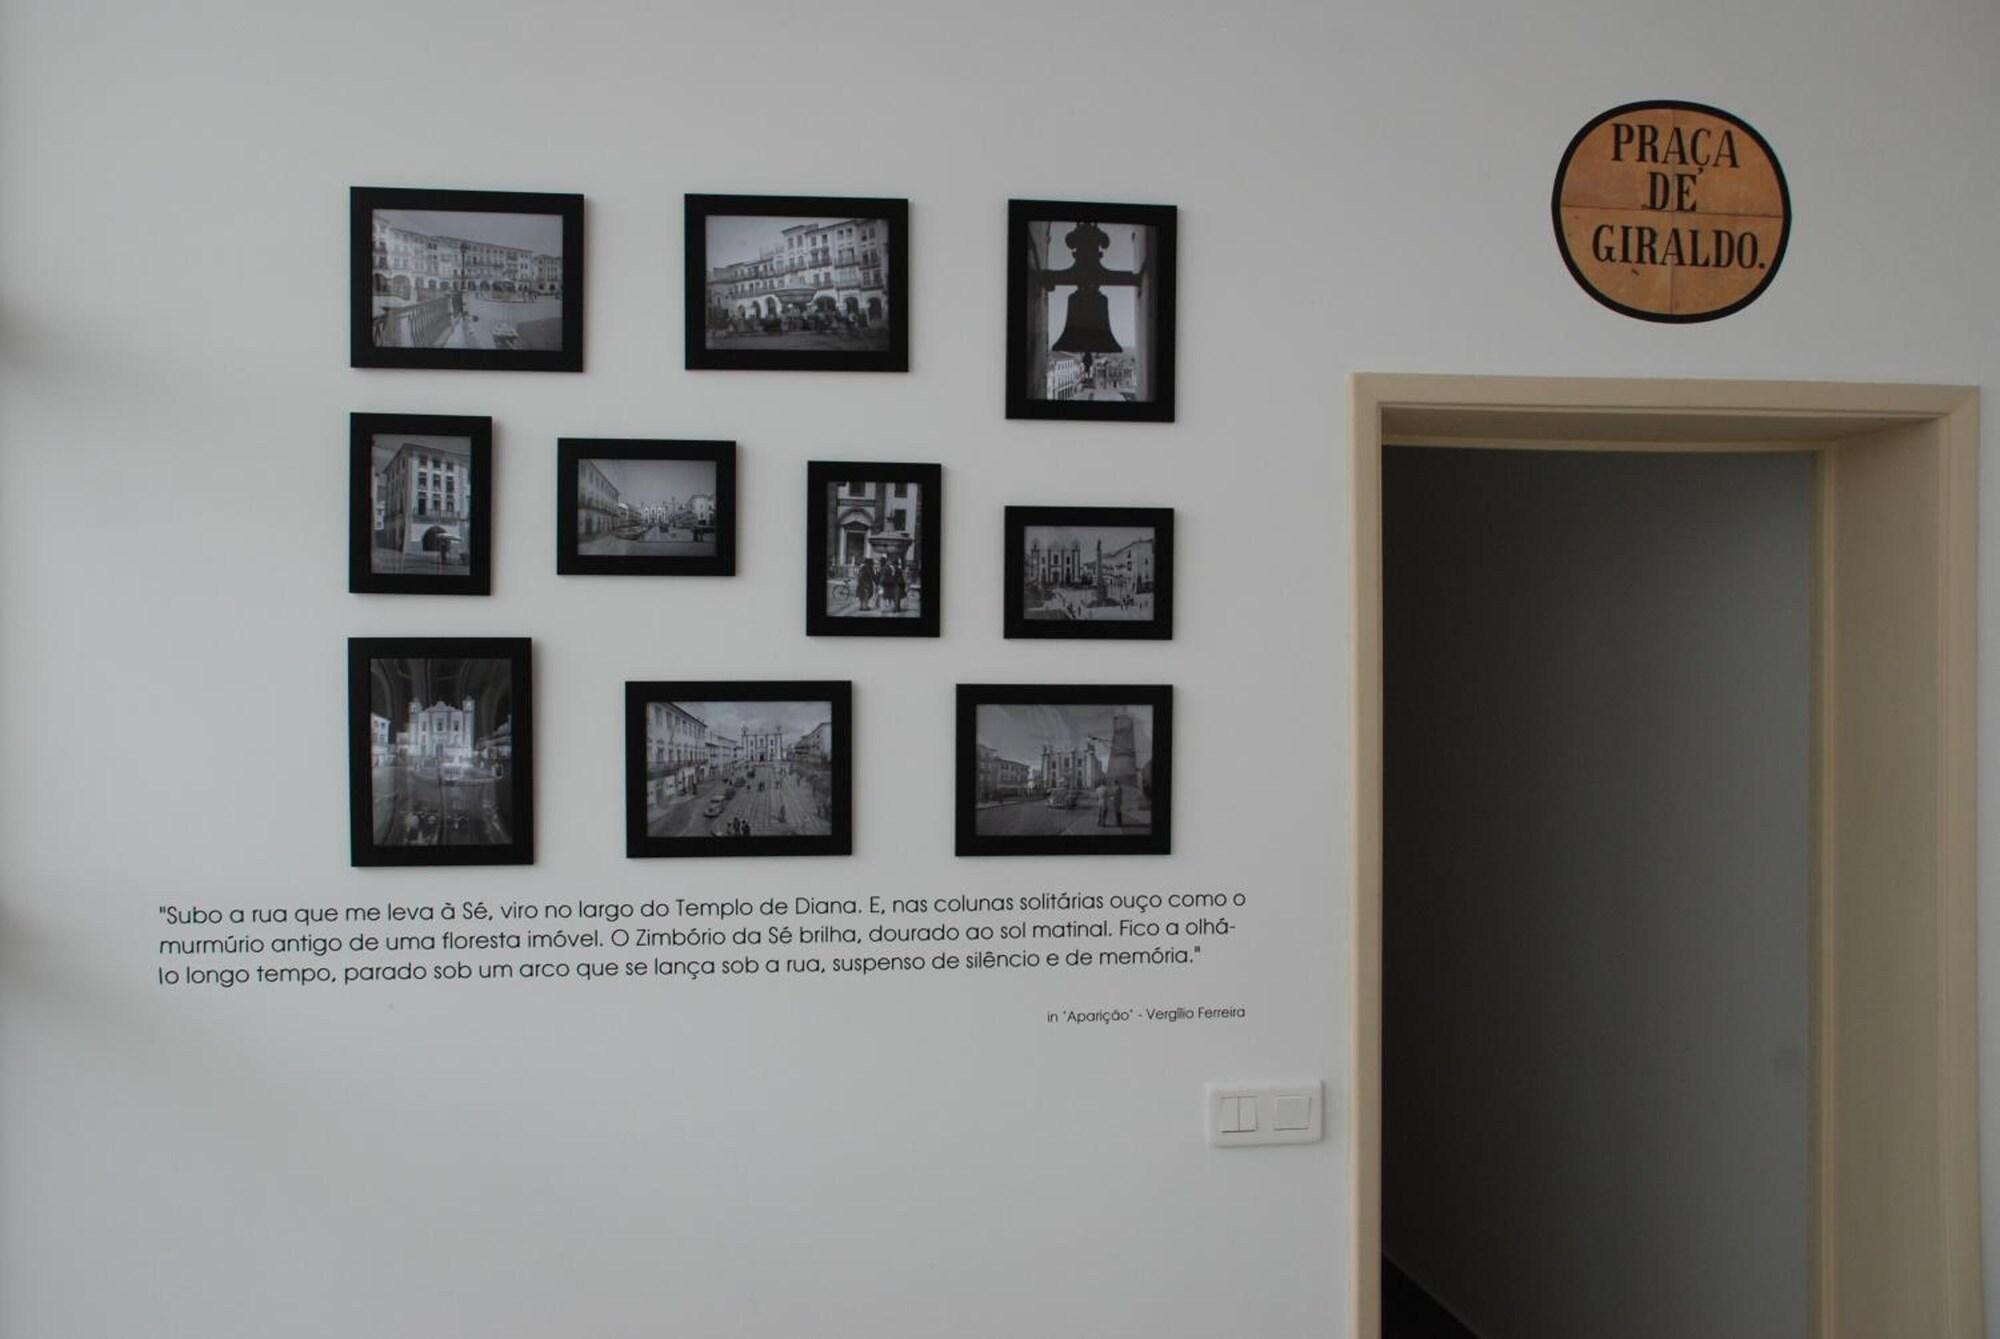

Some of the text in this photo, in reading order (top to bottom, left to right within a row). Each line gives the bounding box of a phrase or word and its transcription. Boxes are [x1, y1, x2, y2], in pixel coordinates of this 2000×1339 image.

[1611, 123, 1740, 174] PRAÇA
[1641, 171, 1697, 212] DE
[1592, 223, 1765, 269] GIRALDO.
[228, 908, 245, 924] a
[251, 908, 288, 924] rua
[293, 907, 339, 927] que
[344, 906, 382, 923] me
[387, 902, 435, 922] leva
[440, 901, 456, 921] à
[461, 900, 494, 922] Sé,
[499, 900, 539, 920] viro
[544, 904, 573, 919] no
[578, 899, 635, 923] largo
[639, 898, 671, 918] do
[674, 897, 754, 921] Templo
[759, 897, 789, 916] de
[794, 896, 863, 916] Diana.
[869, 895, 886, 916] E,
[892, 898, 929, 914] nas
[933, 893, 1015, 913] colunas
[1019, 891, 1104, 911] solitárias
[1109, 893, 1163, 914] ouço
[1167, 892, 1228, 909] como
[1232, 892, 1247, 907] o
[159, 916, 1236, 957] murmúrio antigo de uma floresta imóvel. O Zimbório da Sé brilha, dourado ao sol matinal. Fico a olhá-
[157, 966, 180, 986] lo
[186, 965, 251, 989] longo
[255, 964, 337, 987] tempo,
[343, 961, 428, 986] parado
[433, 960, 473, 981] sob
[477, 963, 514, 979] um
[518, 962, 571, 979] arco
[575, 961, 620, 981] que
[624, 961, 649, 977] se
[653, 956, 716, 981] lança
[721, 955, 760, 975] sob
[764, 959, 780, 974] a
[786, 957, 826, 974] rua,
[832, 955, 926, 976] suspenso
[930, 951, 961, 970] de
[965, 949, 1041, 970] silêncio
[1045, 952, 1060, 967] e
[1064, 948, 1093, 967] de
[1047, 1011, 1059, 1023] in
[1197, 1005, 1246, 1020] Ferreira
